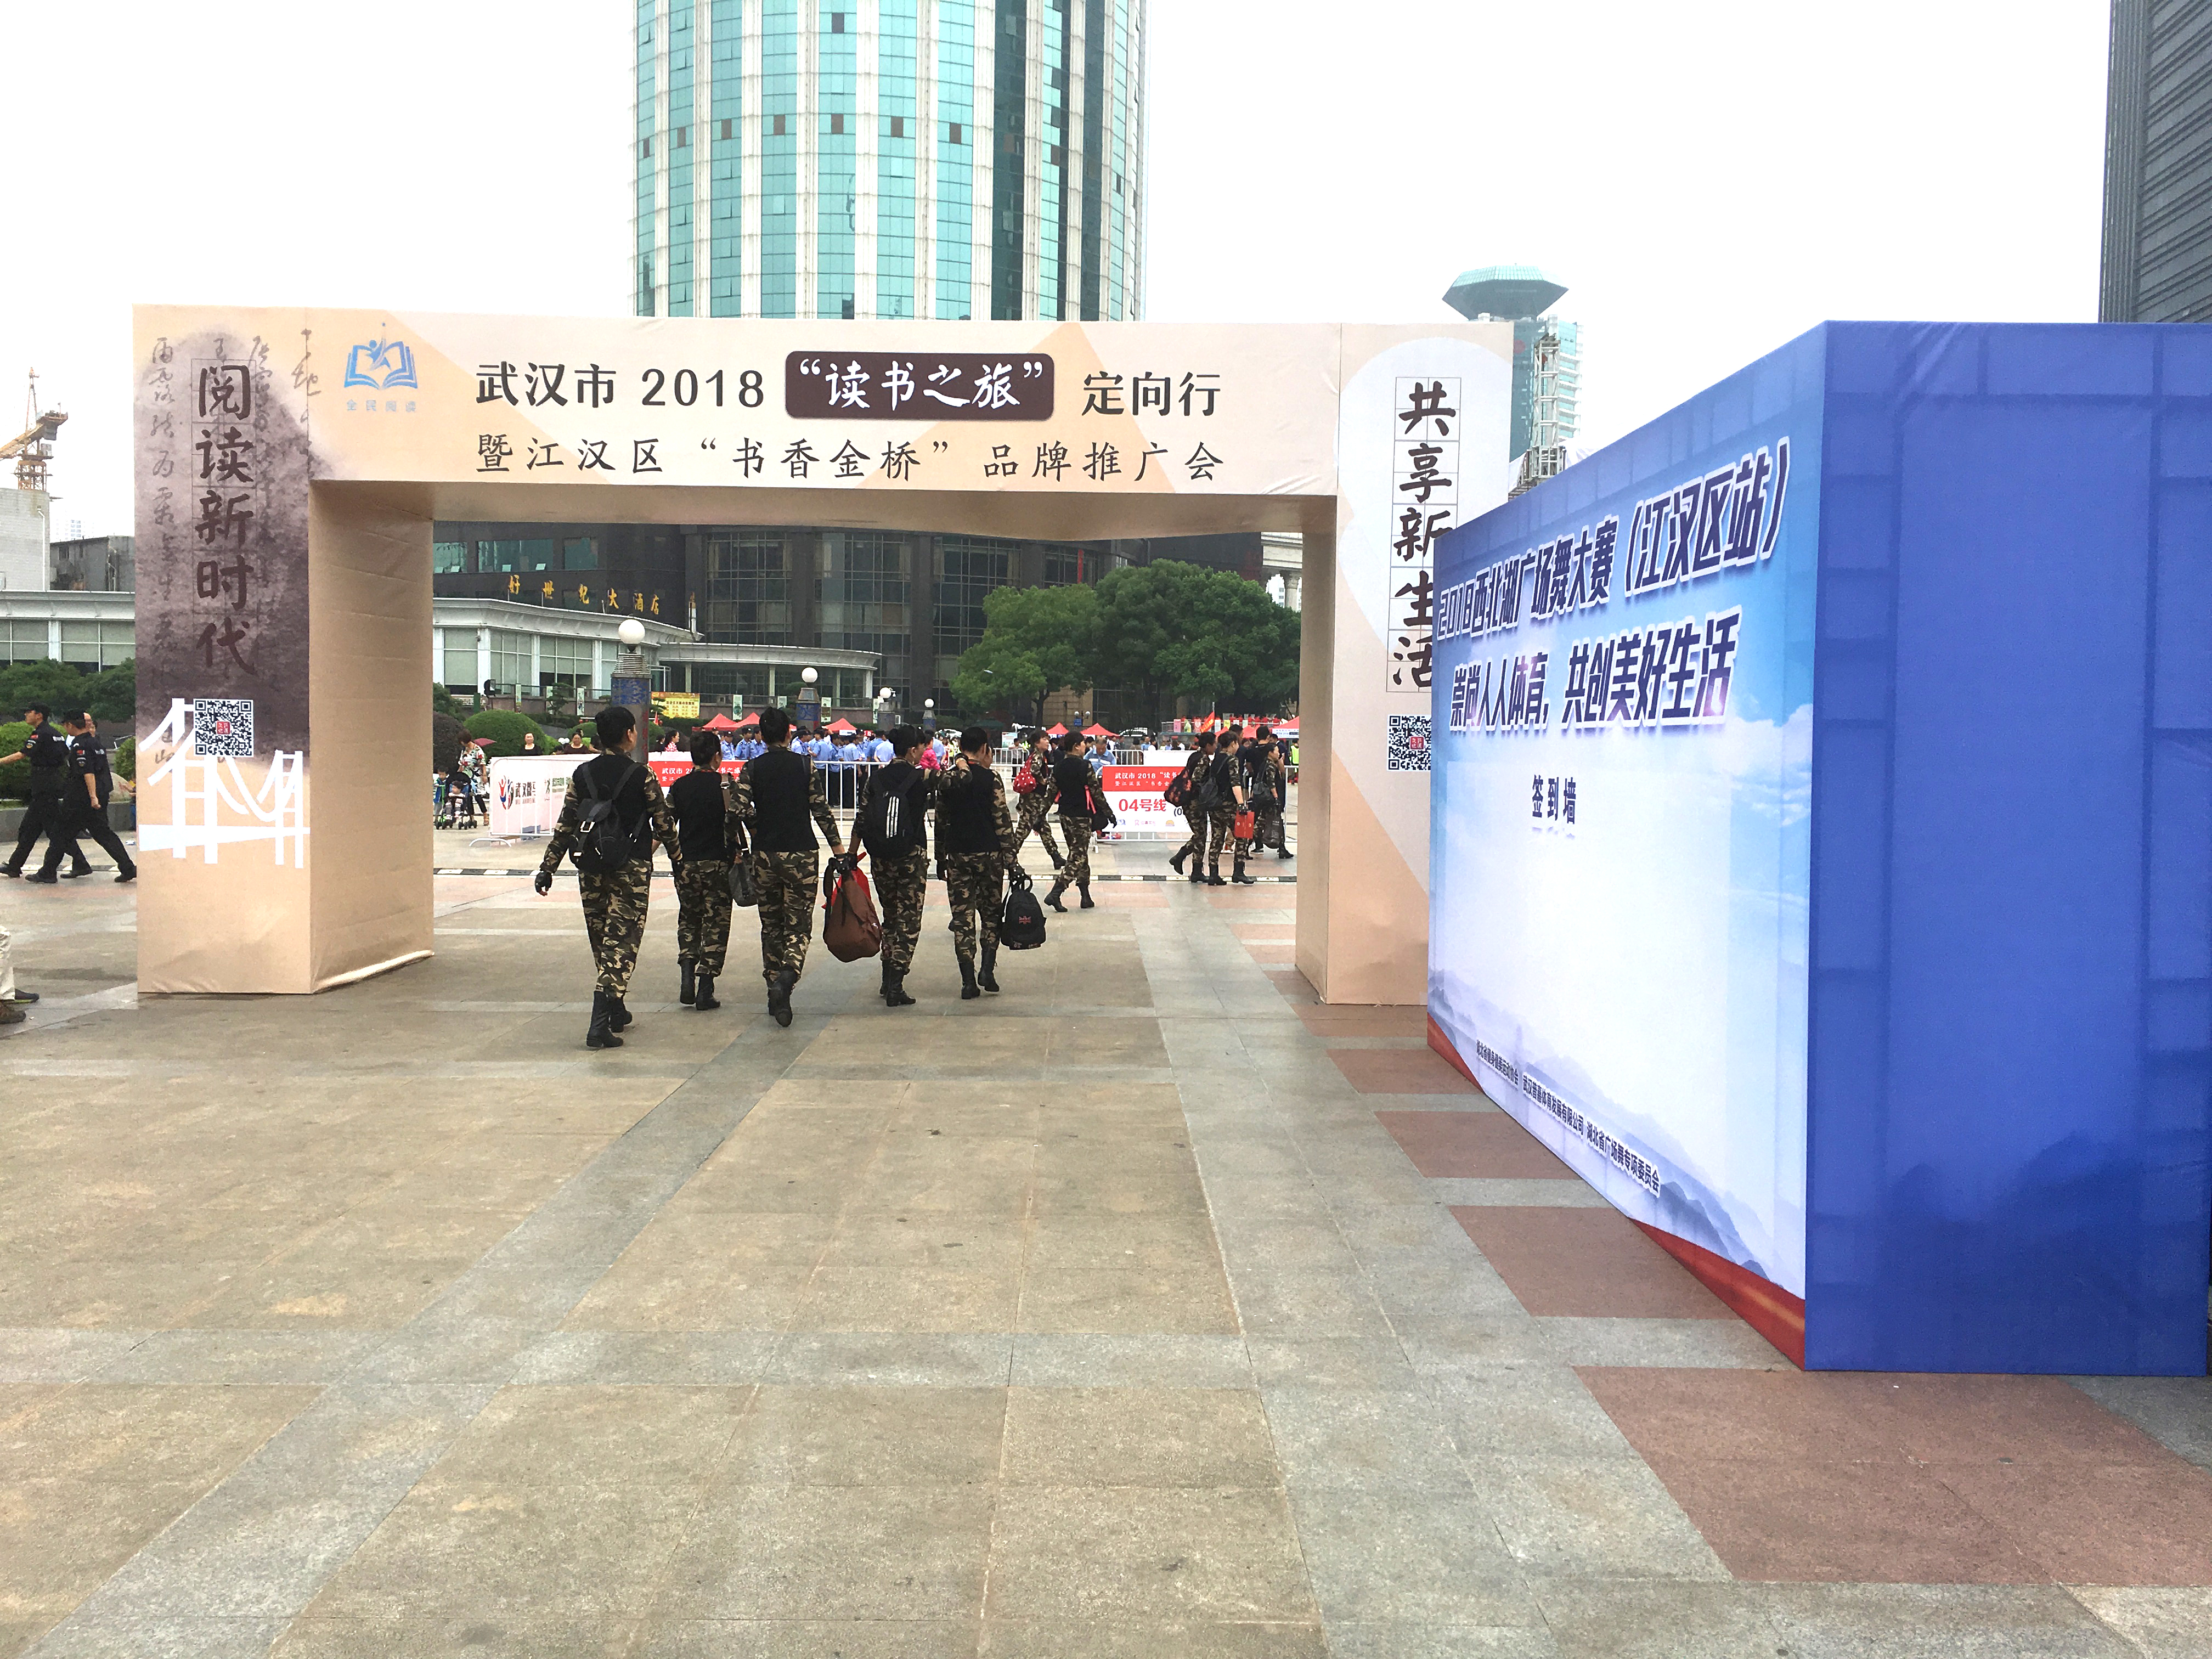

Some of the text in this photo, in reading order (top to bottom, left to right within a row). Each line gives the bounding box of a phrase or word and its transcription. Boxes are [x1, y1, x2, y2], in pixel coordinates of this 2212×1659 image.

[476, 361, 616, 408] 武汉市
[641, 369, 764, 407] 2018
[1081, 371, 1221, 416] 定向行
[195, 364, 255, 675] 阅读新时代
[1393, 381, 1456, 688] 共享新生活
[508, 574, 659, 614] 好世纪大酒店
[1119, 799, 1167, 812] 04号线
[1532, 774, 1576, 825] 签到墙
[1587, 1120, 1660, 1194] 湖北省广场舞专项委员会
